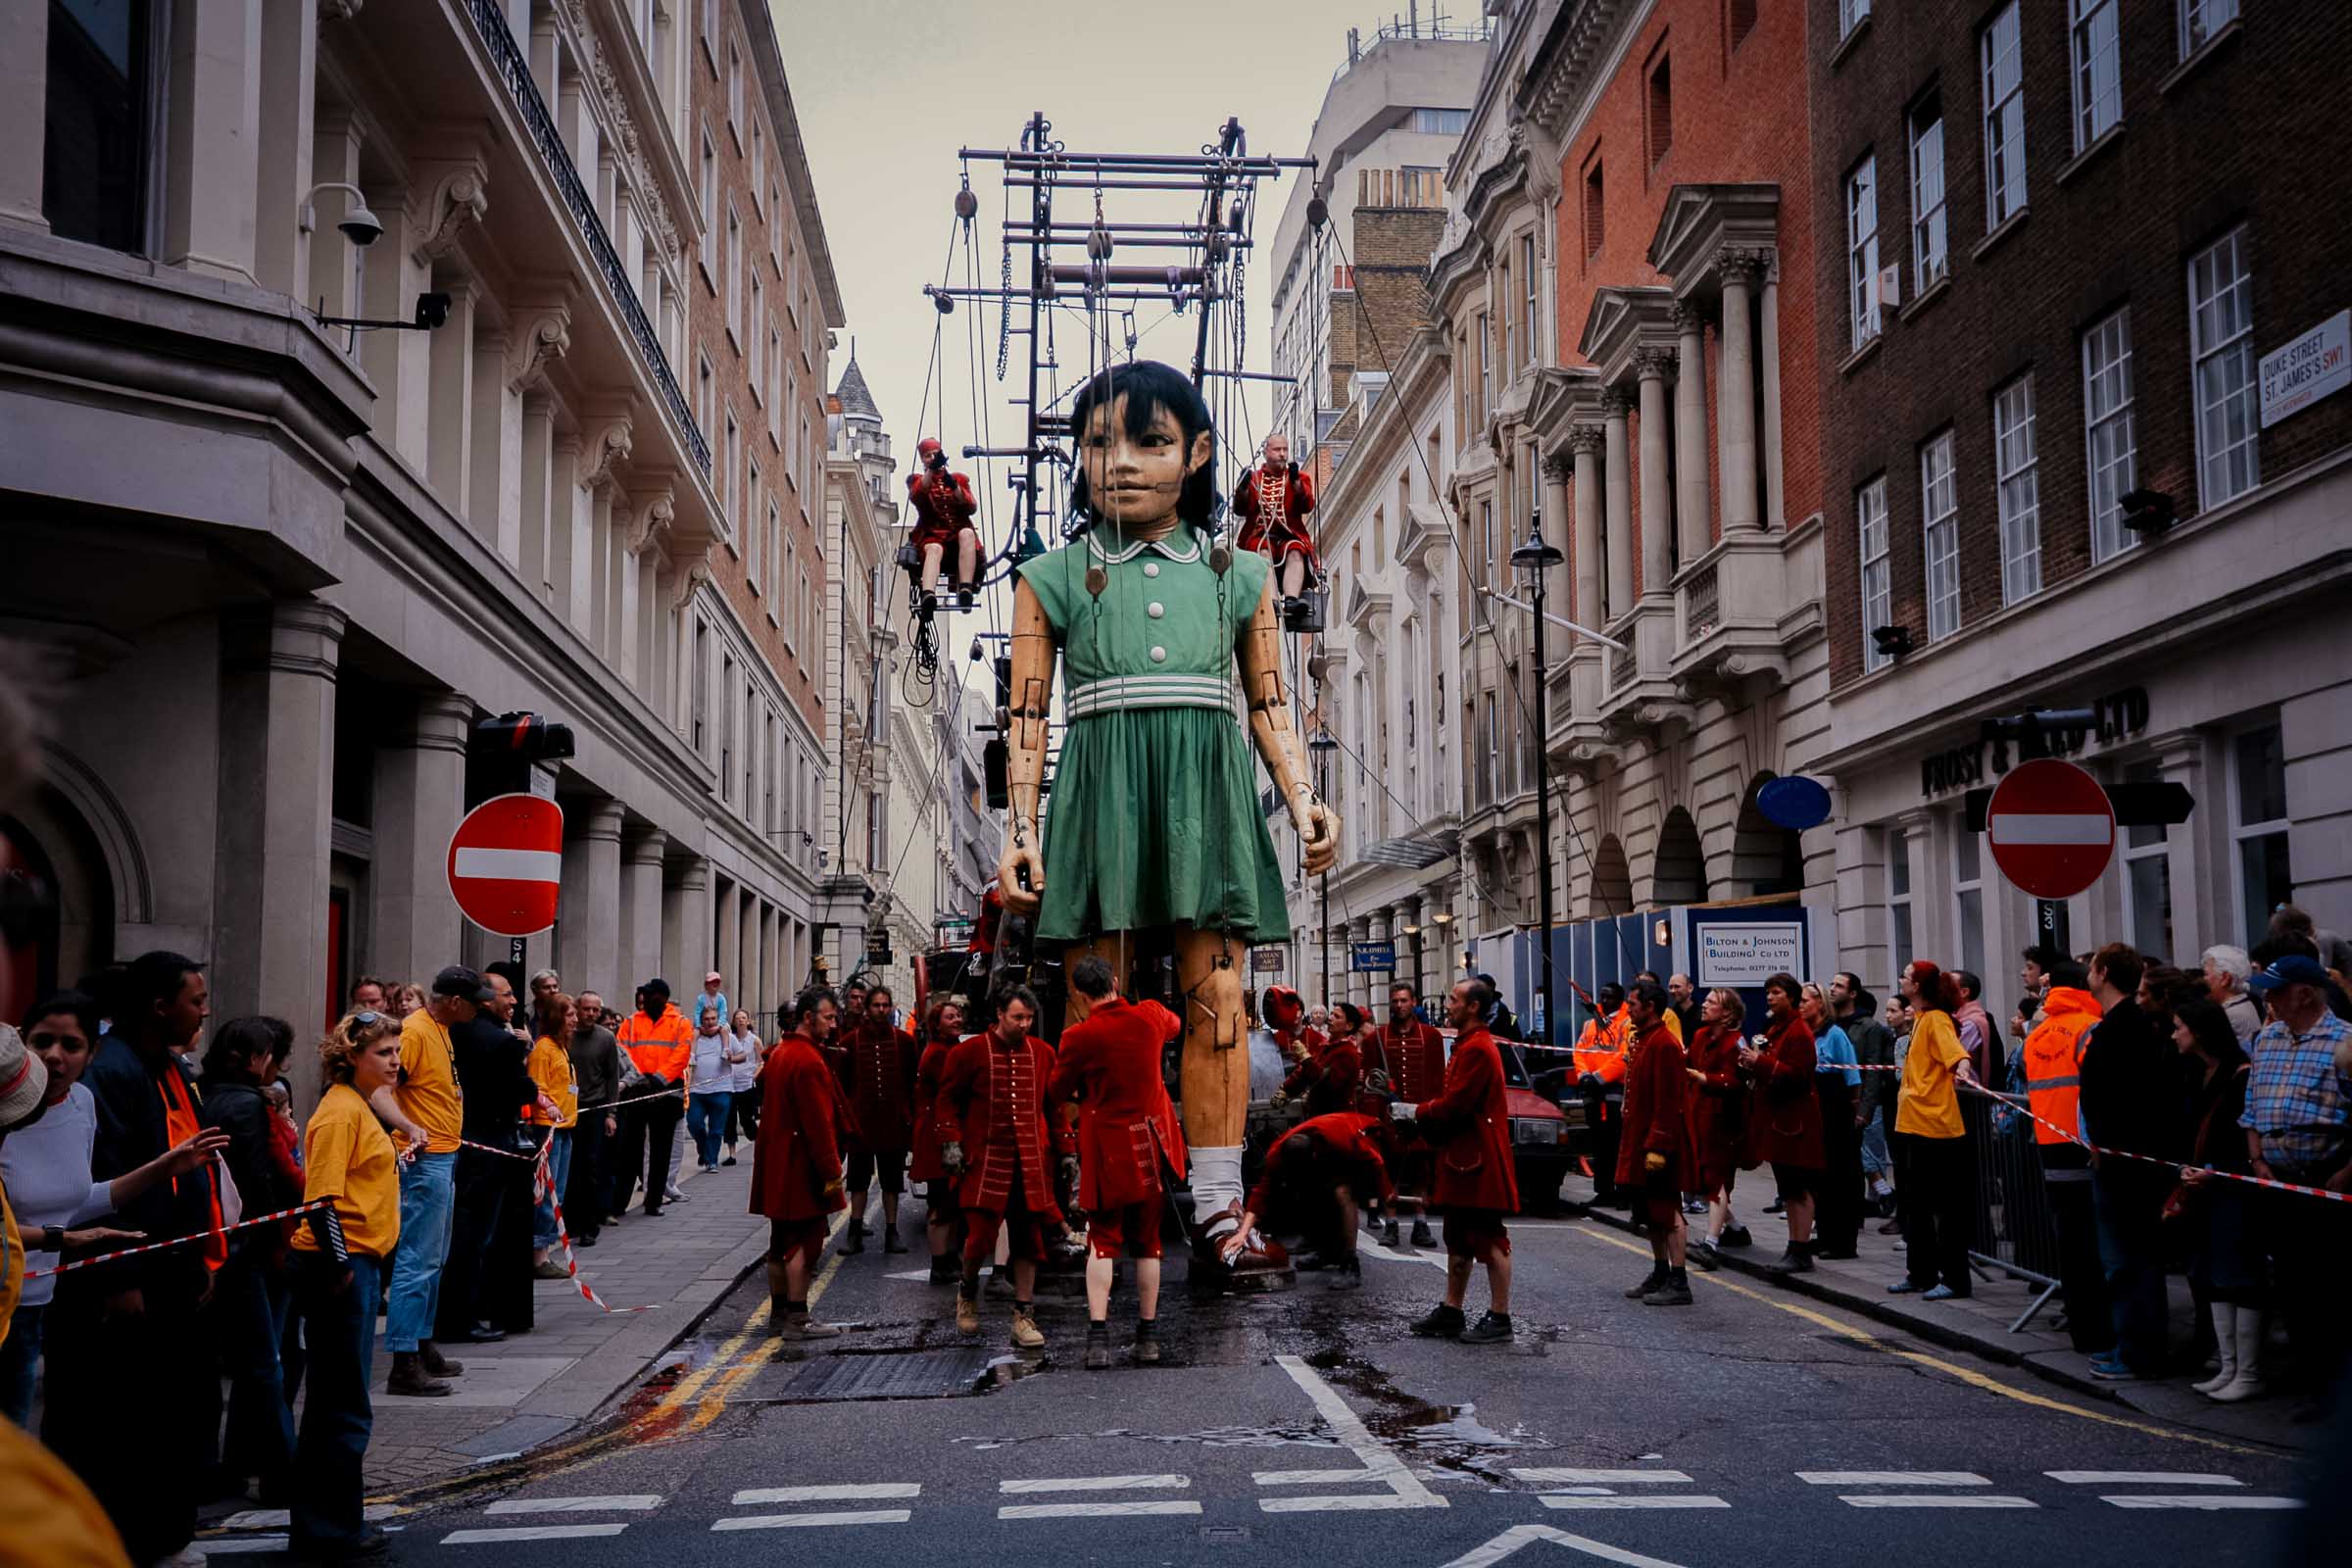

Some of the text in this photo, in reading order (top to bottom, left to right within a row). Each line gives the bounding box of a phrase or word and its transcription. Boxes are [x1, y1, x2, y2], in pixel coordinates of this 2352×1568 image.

[2264, 332, 2324, 380] DUKE STREET
[2281, 358, 2321, 393] JAMES'S
[2323, 345, 2343, 370] SW1
[1922, 744, 1983, 795] FROST
[2094, 687, 2148, 744] LTD
[513, 939, 522, 964] S4
